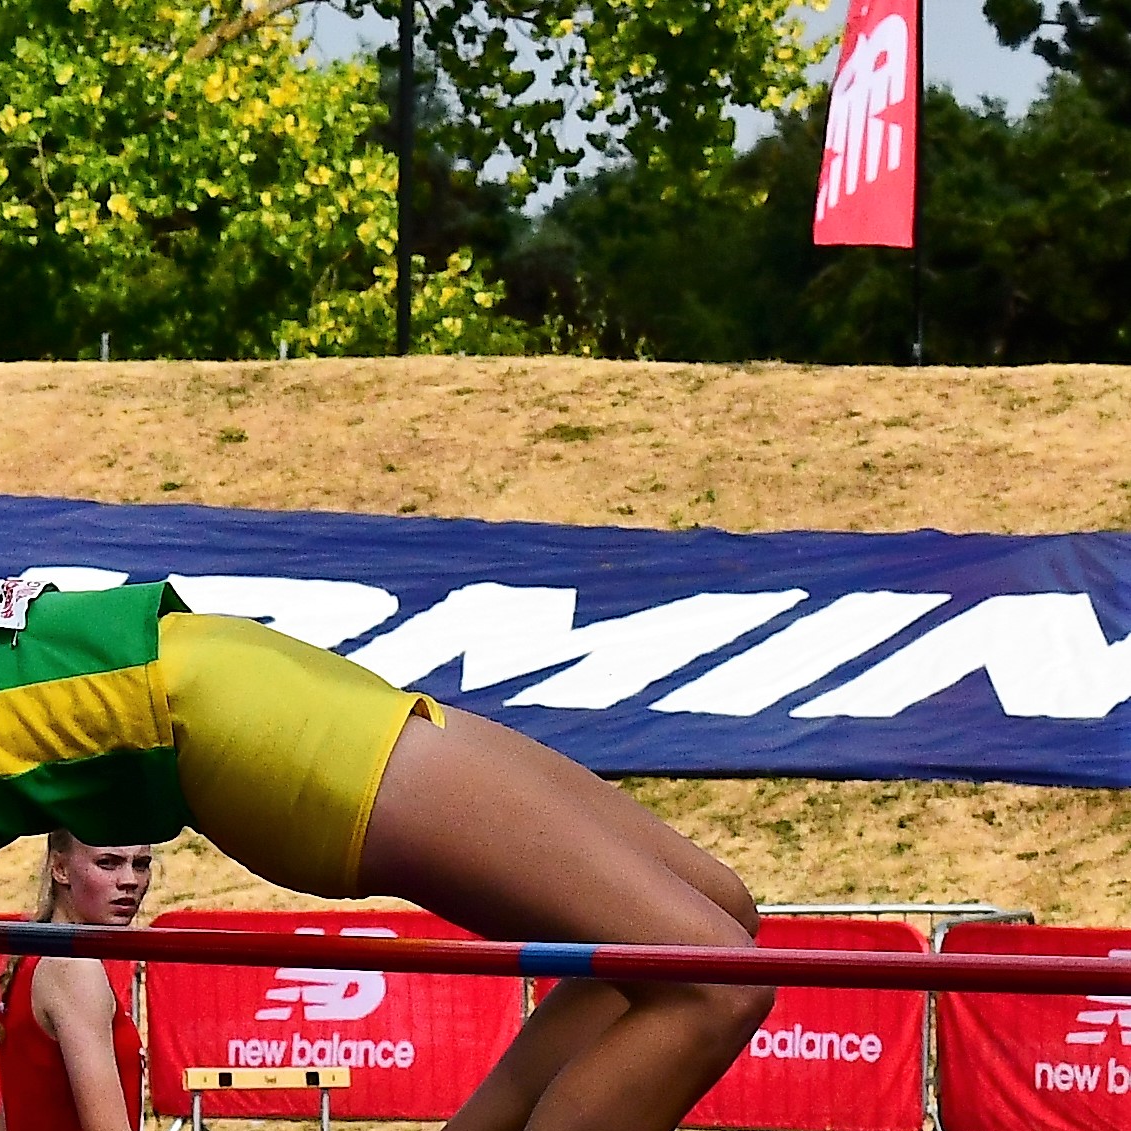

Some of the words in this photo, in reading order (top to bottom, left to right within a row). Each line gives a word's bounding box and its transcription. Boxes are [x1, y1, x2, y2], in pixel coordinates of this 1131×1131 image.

[228, 1037, 287, 1067] new
[291, 1032, 415, 1069] balance
[749, 1023, 883, 1063] balance
[1034, 1060, 1102, 1091] new
